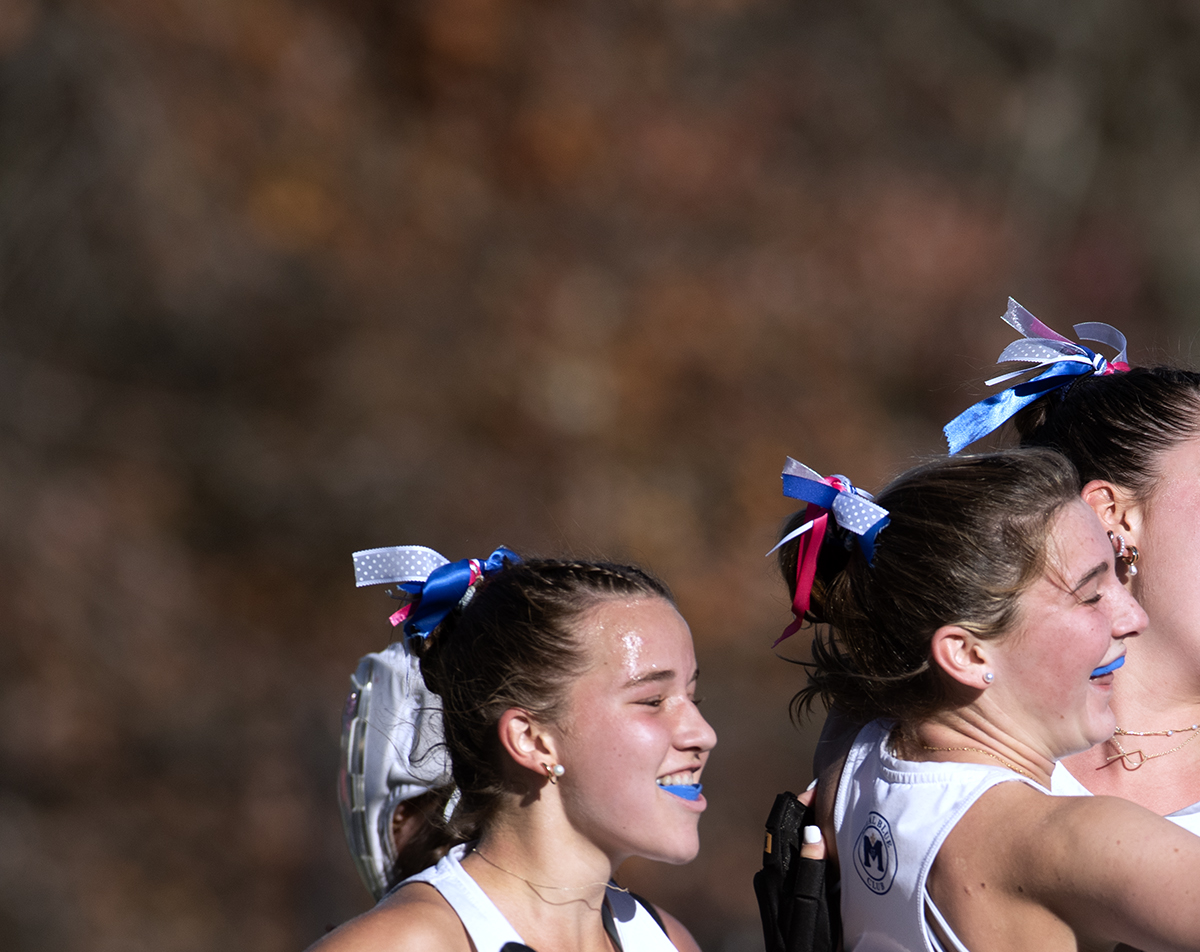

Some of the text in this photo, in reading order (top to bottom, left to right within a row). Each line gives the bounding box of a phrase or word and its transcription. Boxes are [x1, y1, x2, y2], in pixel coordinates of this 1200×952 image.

[877, 820, 892, 848] BLUE
[864, 835, 884, 872] M
[867, 877, 885, 891] CLUB
